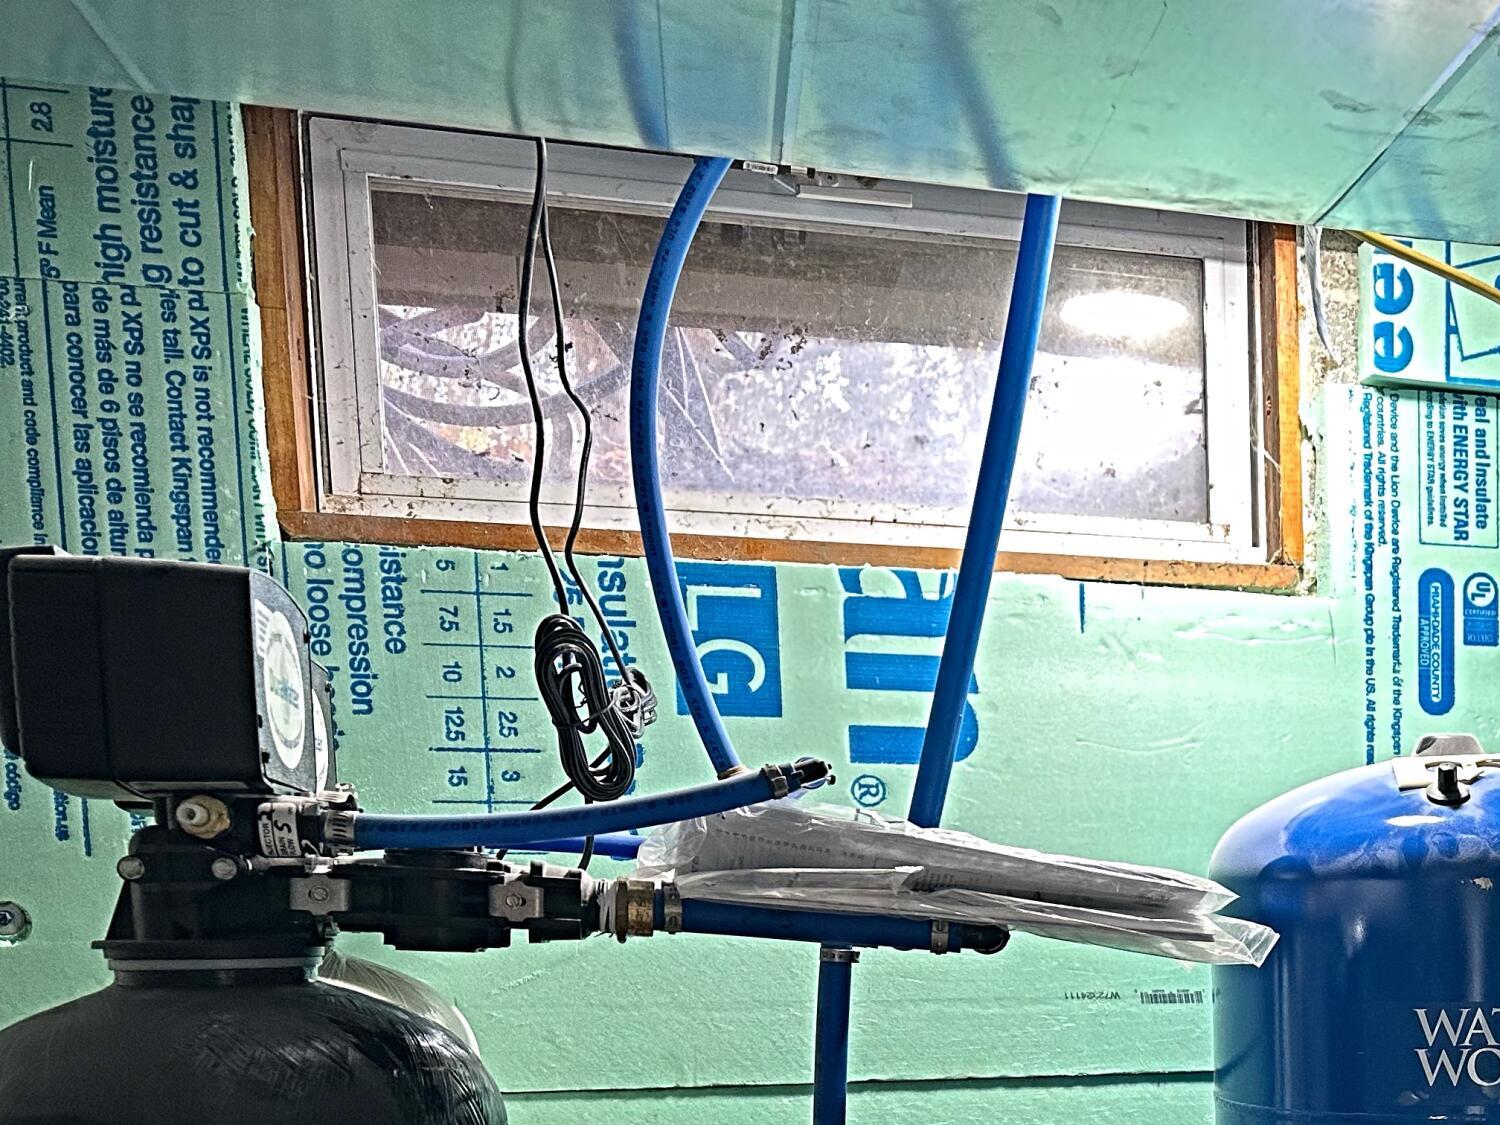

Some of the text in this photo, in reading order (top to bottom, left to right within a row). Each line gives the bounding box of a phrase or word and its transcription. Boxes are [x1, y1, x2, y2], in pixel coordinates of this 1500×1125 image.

[31, 186, 53, 238] Mean
[129, 95, 163, 254] resistance
[168, 169, 204, 287] to cut &
[14, 318, 46, 530] product and code compliance
[66, 332, 93, 452] conocer las
[91, 287, 123, 474] de más de 6 pisos
[120, 311, 156, 542] XPS no se recomienda
[189, 317, 213, 421] XPS is not
[160, 328, 195, 551] tall. Contact Kingspan
[1452, 425, 1469, 541] ENERGY STAR
[1475, 438, 1489, 529] and Insulate
[308, 579, 334, 656] loose
[686, 585, 766, 695] LG
[1419, 619, 1430, 666] APPROVED
[1470, 582, 1491, 602] UL
[435, 560, 468, 787] 5 7.5 10 12.5 15
[492, 609, 519, 738] 1.5 2 2.5
[1431, 652, 1440, 700] COUNTY
